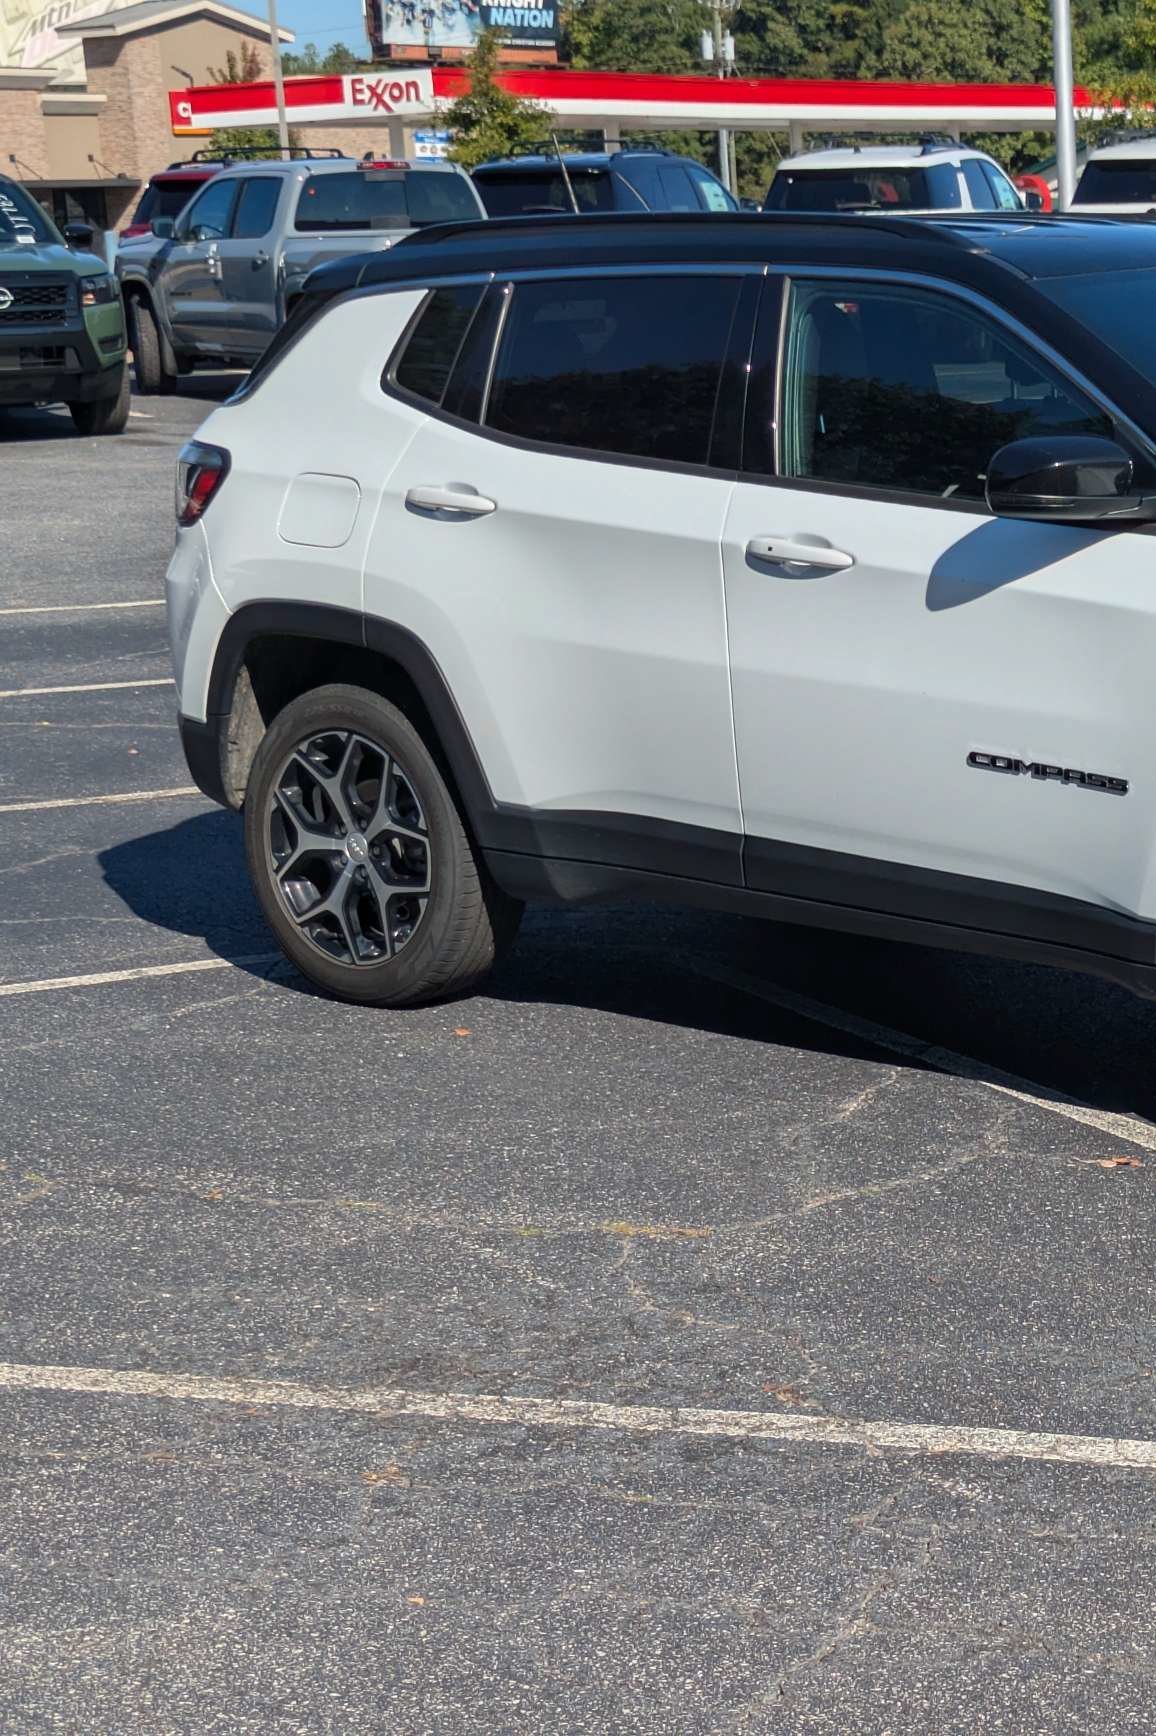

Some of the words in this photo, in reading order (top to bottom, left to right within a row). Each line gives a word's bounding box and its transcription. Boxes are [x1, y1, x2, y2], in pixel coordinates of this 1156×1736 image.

[490, 7, 554, 28] NATION
[351, 79, 420, 113] Exxon
[967, 752, 1129, 796] COMPASS
